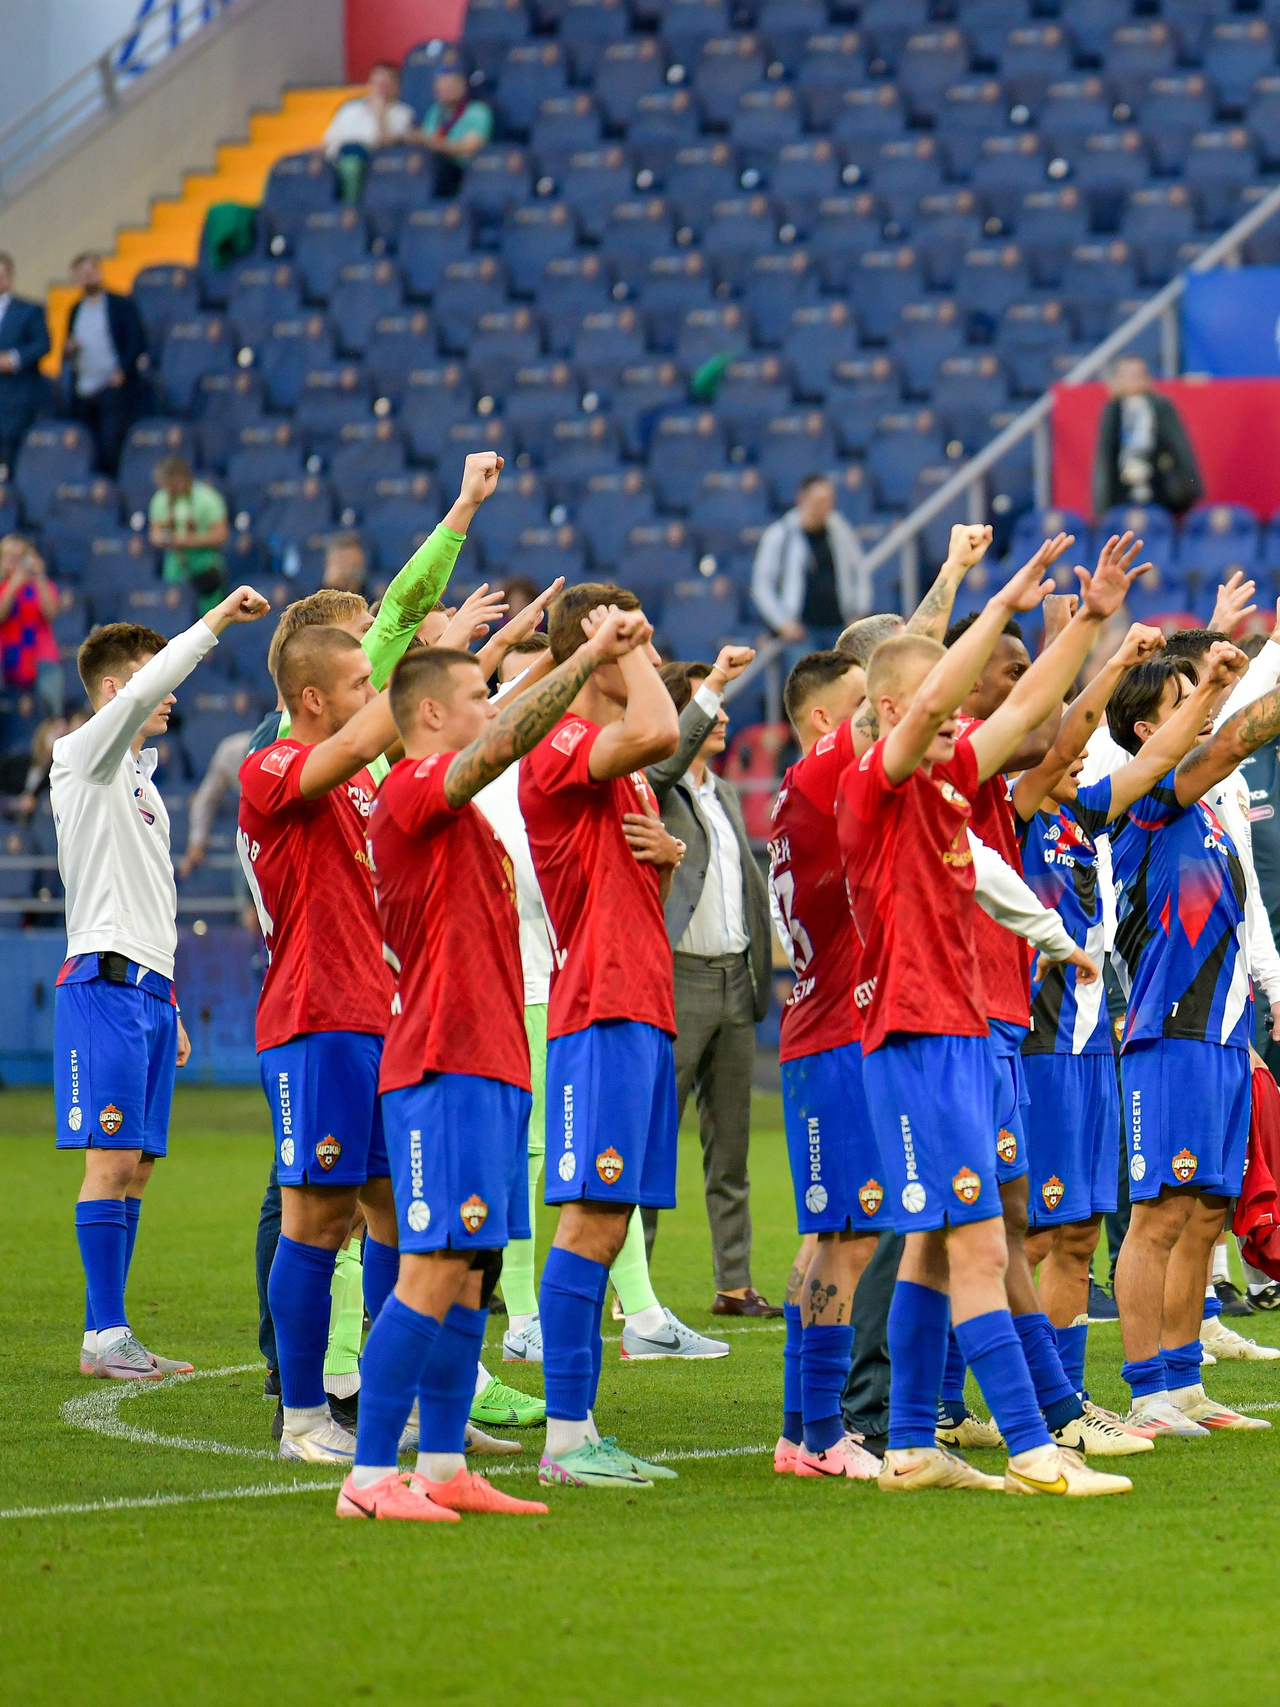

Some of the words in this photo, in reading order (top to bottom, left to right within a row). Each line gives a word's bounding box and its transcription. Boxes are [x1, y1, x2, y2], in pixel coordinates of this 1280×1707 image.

[70, 1049, 80, 1104] РОССЕТИ
[278, 1072, 293, 1135] РОССЕТИ
[564, 1084, 574, 1150] РОССЕТИ
[899, 1114, 919, 1181] РОССЕТИ
[1132, 1090, 1142, 1151] РОССЕТИ
[318, 1144, 341, 1156] ЦСКА
[410, 1129, 424, 1198] РОССЕТИ
[807, 1116, 822, 1182] РОССЕТИ
[1173, 1158, 1197, 1169] ЦСКА
[1044, 1185, 1064, 1197] ЦСКА
